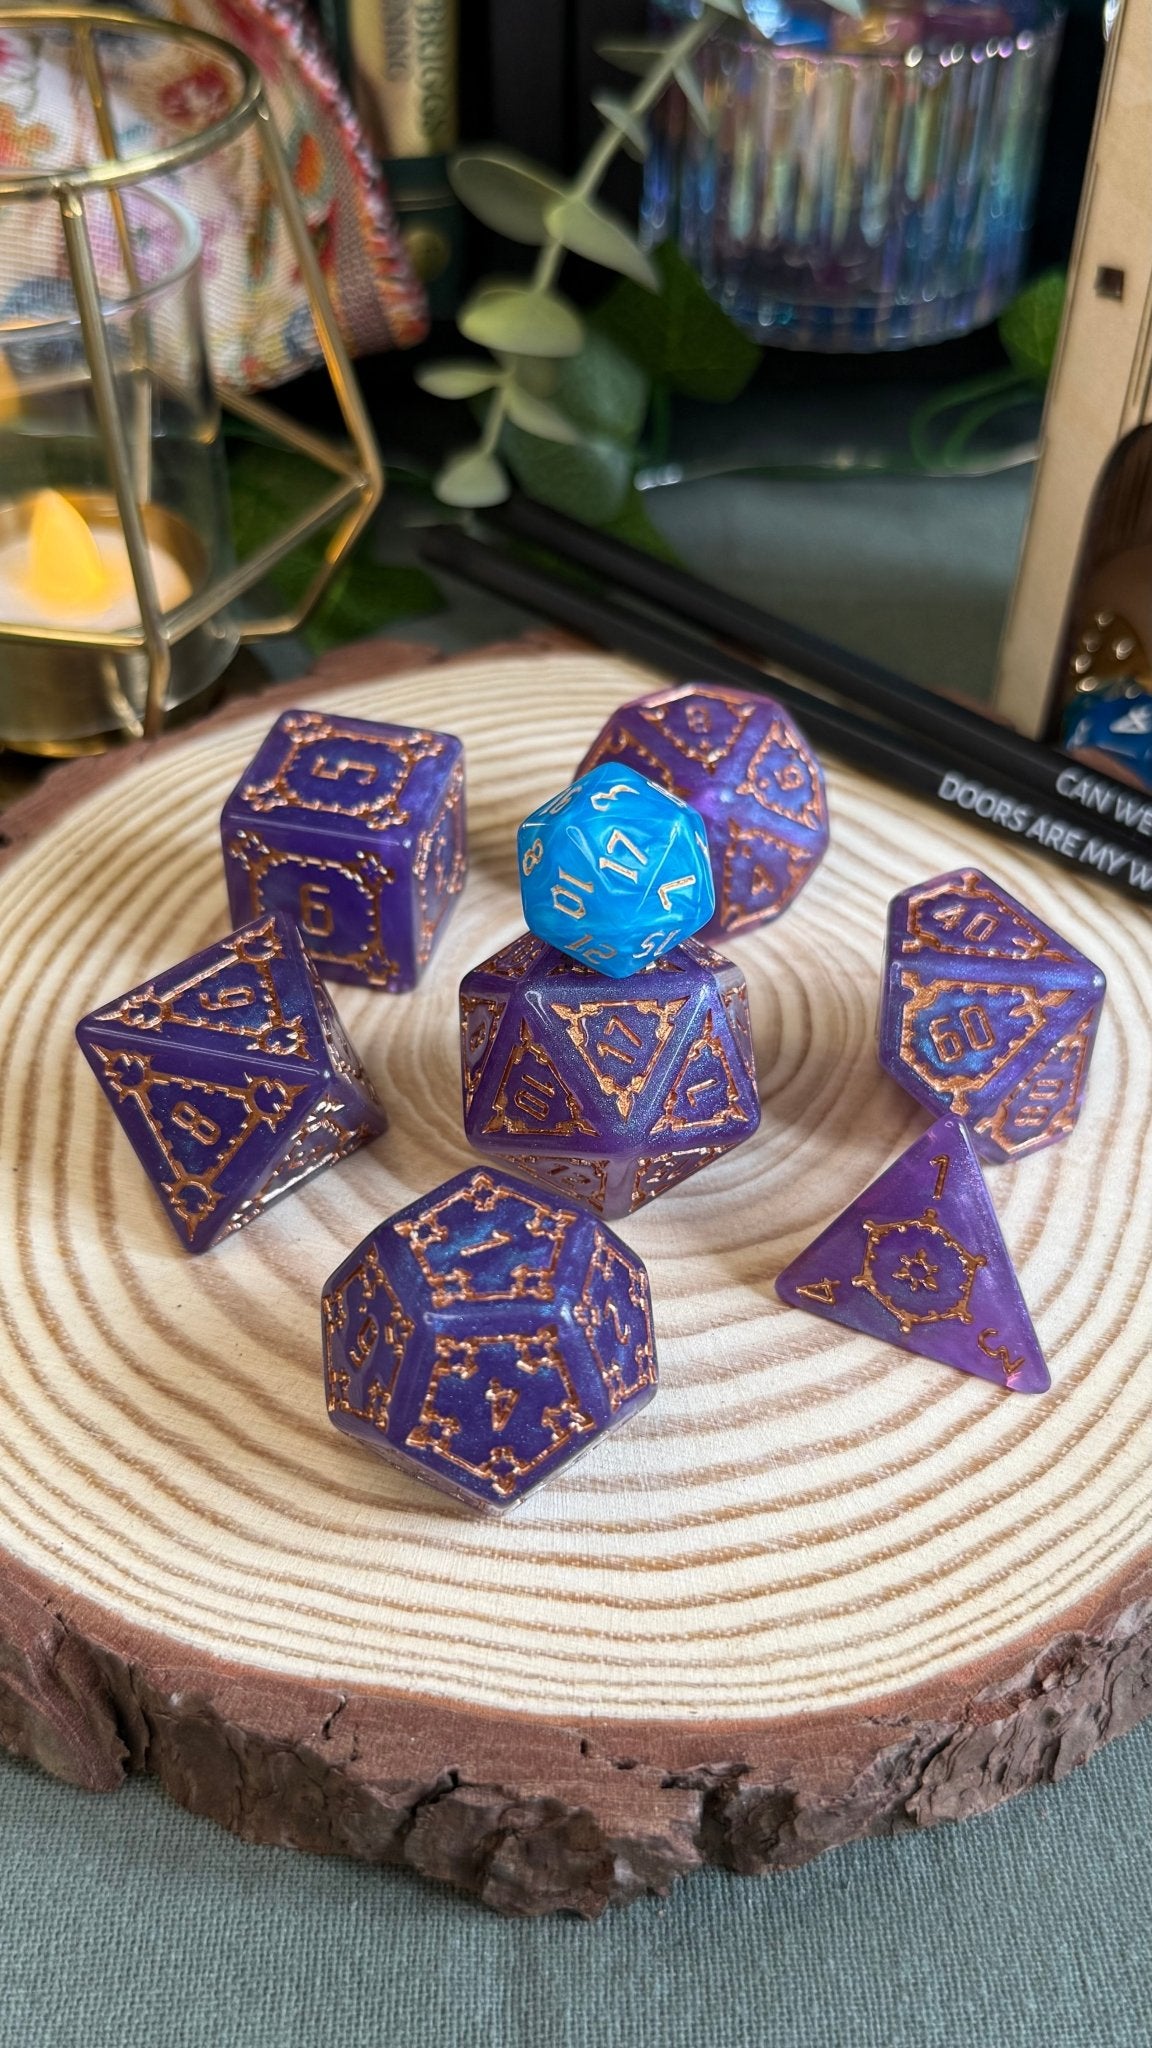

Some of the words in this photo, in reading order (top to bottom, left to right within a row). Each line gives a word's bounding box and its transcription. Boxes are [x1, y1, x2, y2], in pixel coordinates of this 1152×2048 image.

[310, 754, 379, 785] 5
[1056, 768, 1113, 814] CAN
[591, 784, 640, 811] 3
[938, 771, 1030, 832] DOORS
[1026, 816, 1083, 857] ARE
[1079, 838, 1130, 876] MY
[522, 838, 544, 876] 8
[599, 829, 649, 884] 17
[303, 884, 334, 937] 6
[550, 866, 594, 921] 10
[657, 874, 696, 911] 7
[633, 929, 681, 959] 15
[932, 903, 998, 942] 40
[565, 934, 617, 964] 12
[597, 1015, 643, 1065] 17
[929, 1005, 996, 1062] 60
[514, 1073, 555, 1122] 10
[686, 1077, 718, 1108] 7
[172, 1102, 221, 1146] 8
[929, 1154, 950, 1200] 1
[460, 1229, 513, 1257] 1
[796, 1277, 841, 1306] 4
[603, 1300, 632, 1346] 2
[485, 1376, 521, 1431] 4
